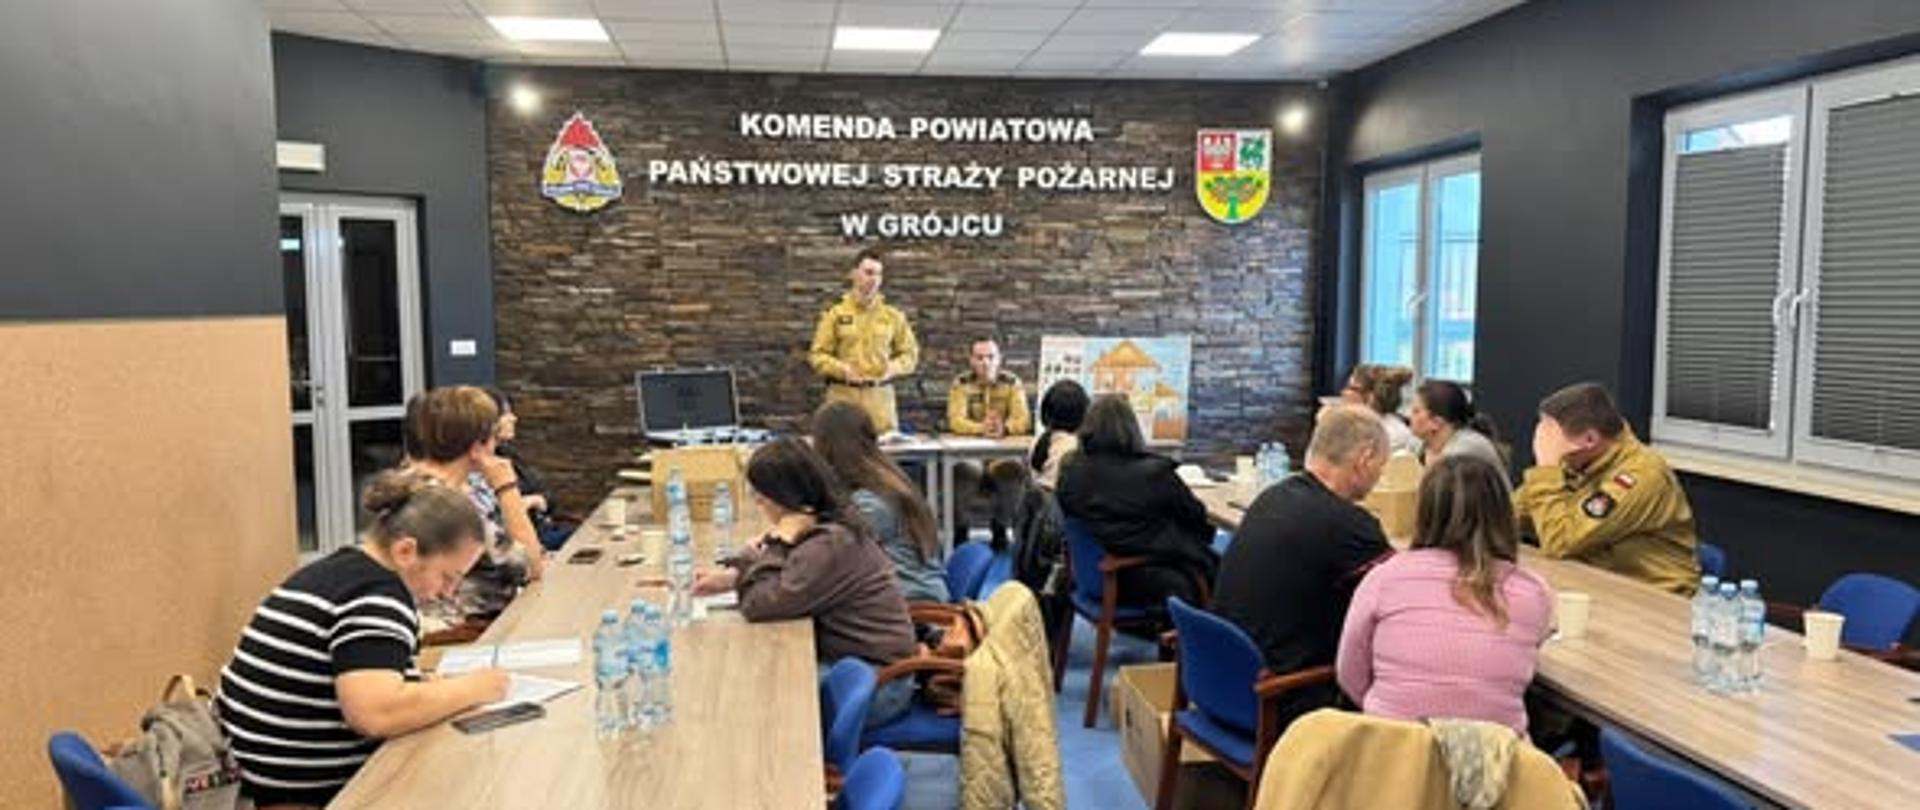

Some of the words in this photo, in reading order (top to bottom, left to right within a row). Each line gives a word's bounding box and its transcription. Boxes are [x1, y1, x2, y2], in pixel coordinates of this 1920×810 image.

[741, 113, 896, 140] KOMENDA
[910, 117, 1094, 142] POWIATOWA
[649, 156, 869, 187] PAŃSTWOWEJ
[882, 161, 1002, 190] STRAŻY
[1018, 161, 1174, 190] POŻARNEJ
[841, 214, 870, 237] W
[877, 210, 1003, 238] GRÓJCU
